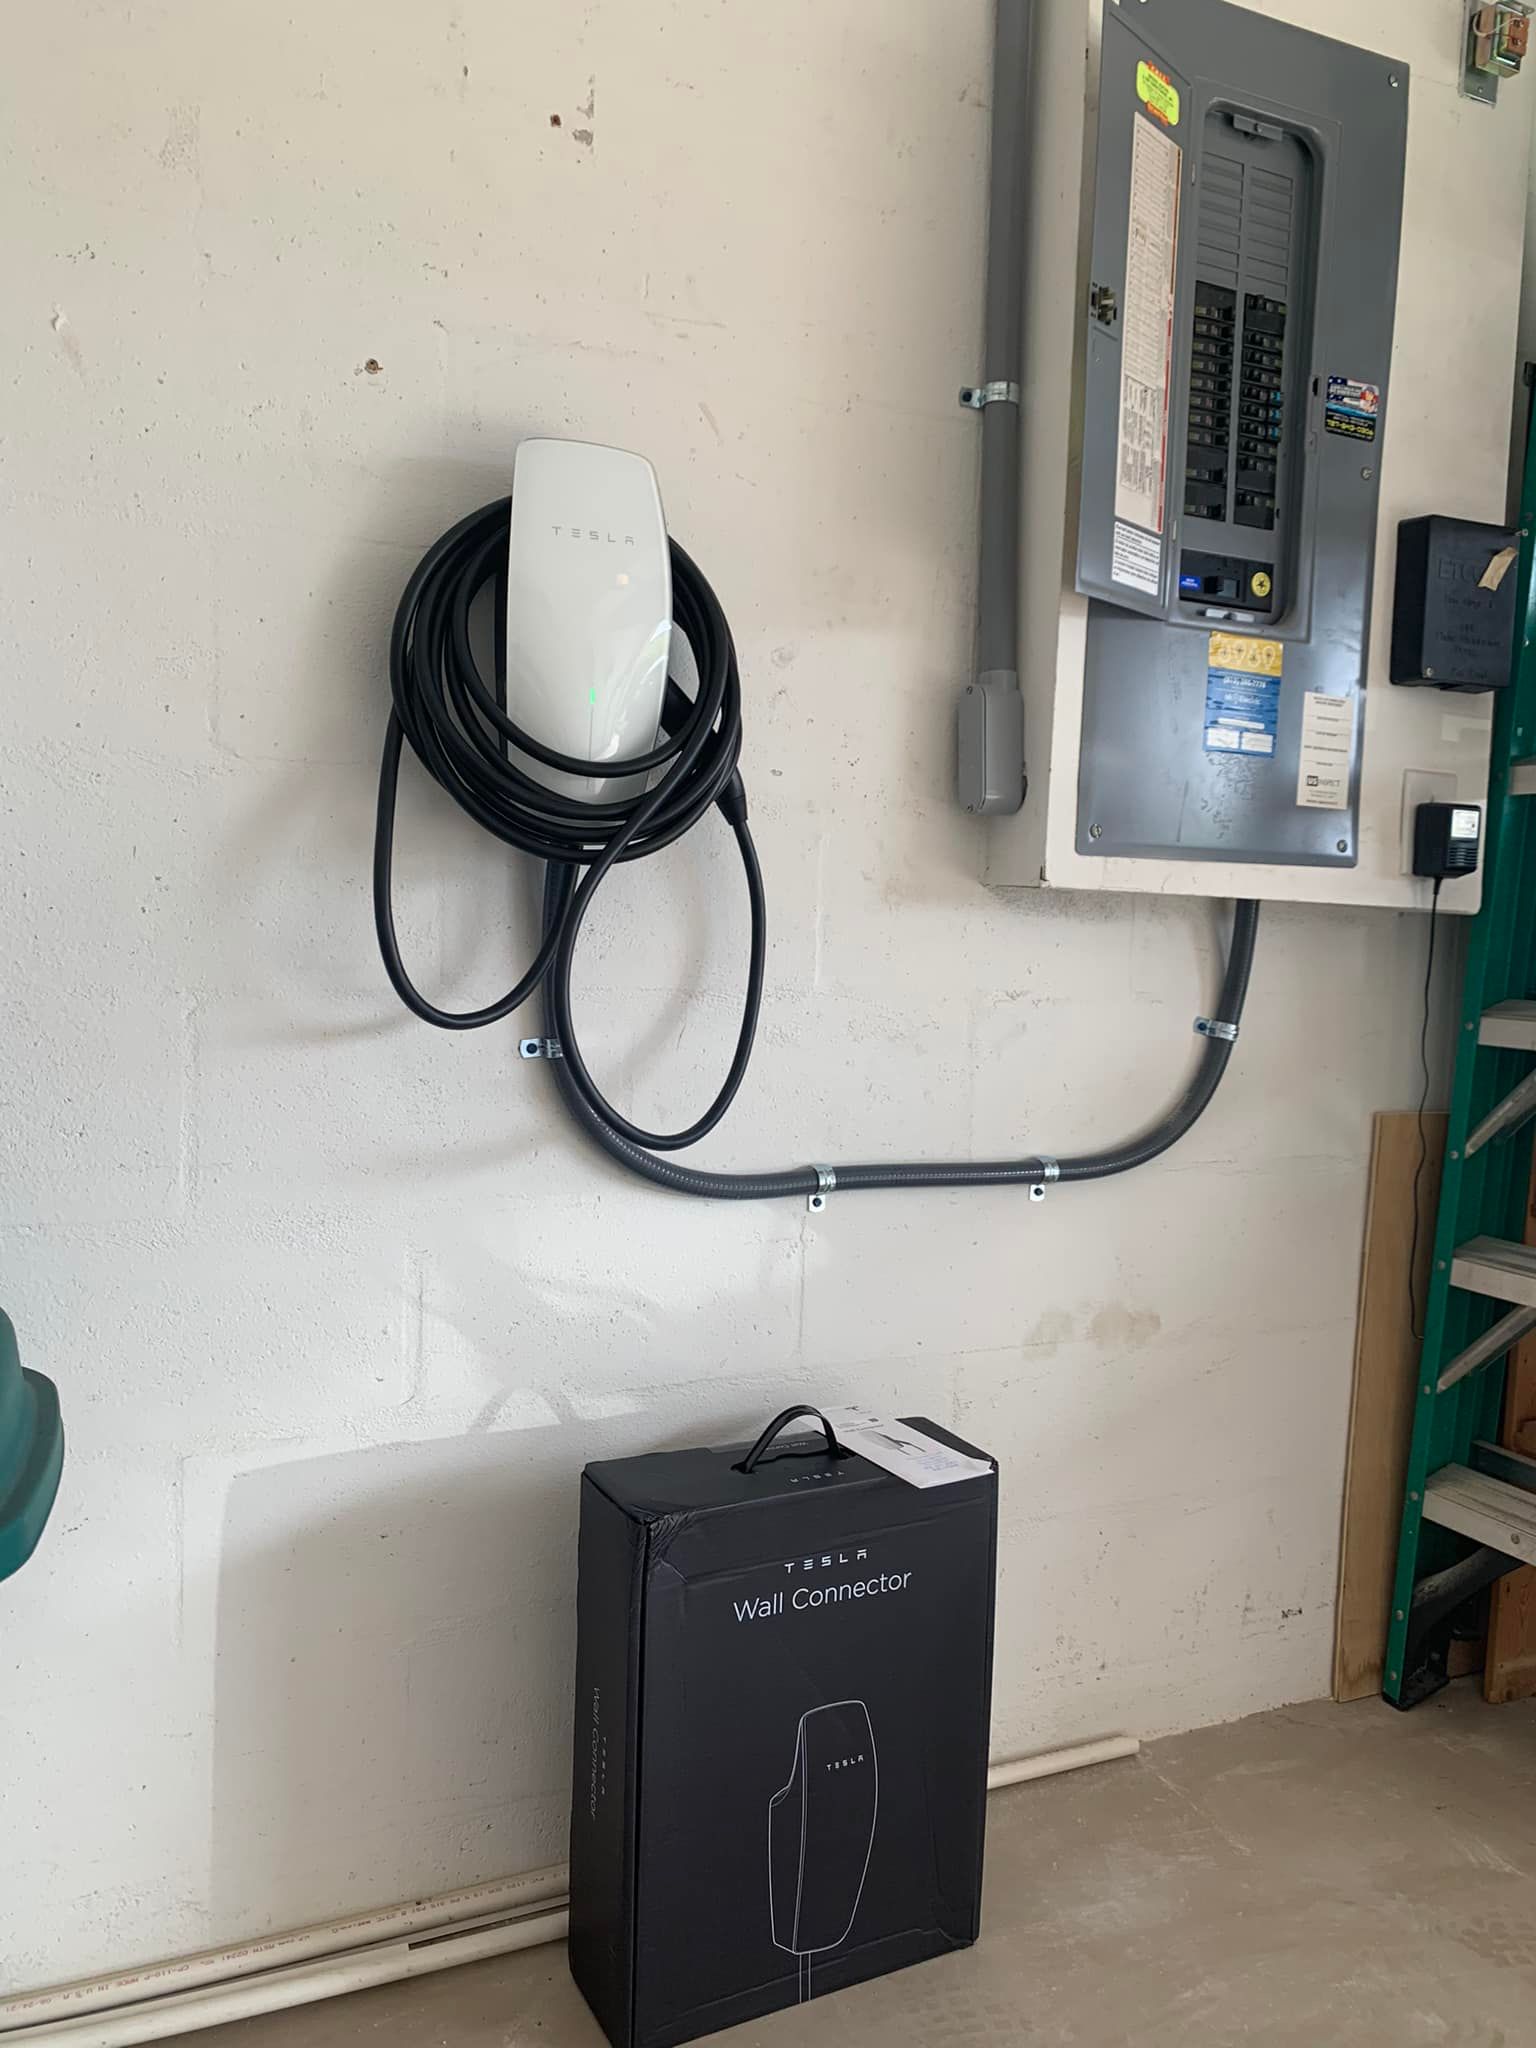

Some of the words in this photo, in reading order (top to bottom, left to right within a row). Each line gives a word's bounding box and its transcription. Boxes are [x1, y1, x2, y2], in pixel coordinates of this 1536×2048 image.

[551, 525, 634, 547] TESLA
[784, 1548, 867, 1574] TESLA
[733, 1591, 784, 1622] Wall
[792, 1570, 912, 1610] Connector
[592, 1686, 601, 1725] Wall
[590, 1727, 600, 1820] Connector
[826, 1754, 864, 1771] TESLA
